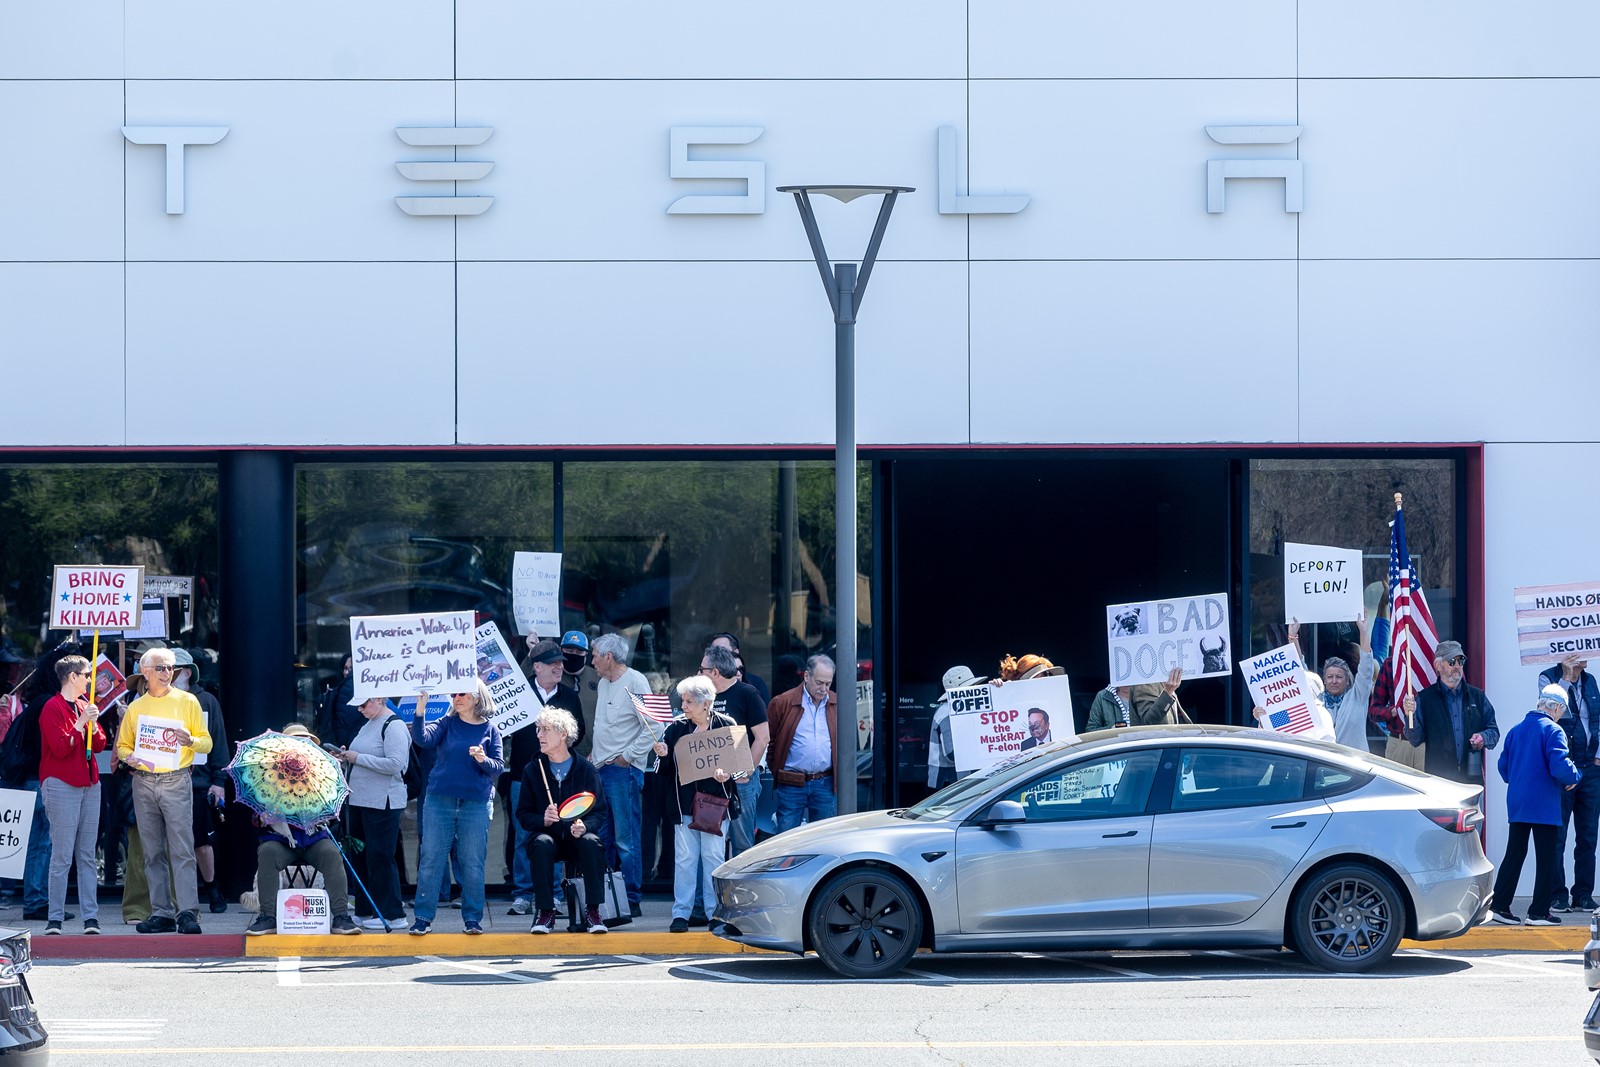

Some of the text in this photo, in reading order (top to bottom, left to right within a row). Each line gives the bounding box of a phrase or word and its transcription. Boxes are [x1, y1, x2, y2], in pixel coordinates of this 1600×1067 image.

[121, 125, 1304, 216] TESLA
[516, 567, 534, 577] NO
[1290, 560, 1347, 574] DEPORT
[68, 571, 126, 589] BRING
[1304, 577, 1348, 594] ELON!
[73, 592, 120, 605] HOME
[515, 587, 529, 597] NO
[1536, 595, 1582, 609] HANDS
[60, 610, 130, 626] KILMAR
[1157, 598, 1225, 635] BAD
[1551, 613, 1600, 630] SOCIAL
[354, 620, 414, 641] America
[420, 618, 453, 635] Wake
[453, 617, 471, 635] Up
[355, 646, 394, 663] Silence
[400, 643, 413, 655] is
[1114, 638, 1196, 682] DOGE
[1253, 651, 1286, 670] MAKE
[360, 668, 400, 688] Boycott
[446, 659, 476, 681] Musk
[1249, 660, 1300, 685] AMERICA
[950, 687, 988, 700] HANDS
[1260, 676, 1297, 695] THINK
[1266, 687, 1301, 707] AGAIN
[980, 710, 1019, 725] STOP
[993, 724, 1010, 733] the
[688, 736, 735, 754] HANDS
[980, 731, 1026, 744] MuskRAT
[988, 742, 1020, 753] F-elon
[695, 754, 720, 770] OFF
[305, 898, 324, 906] MUSK
